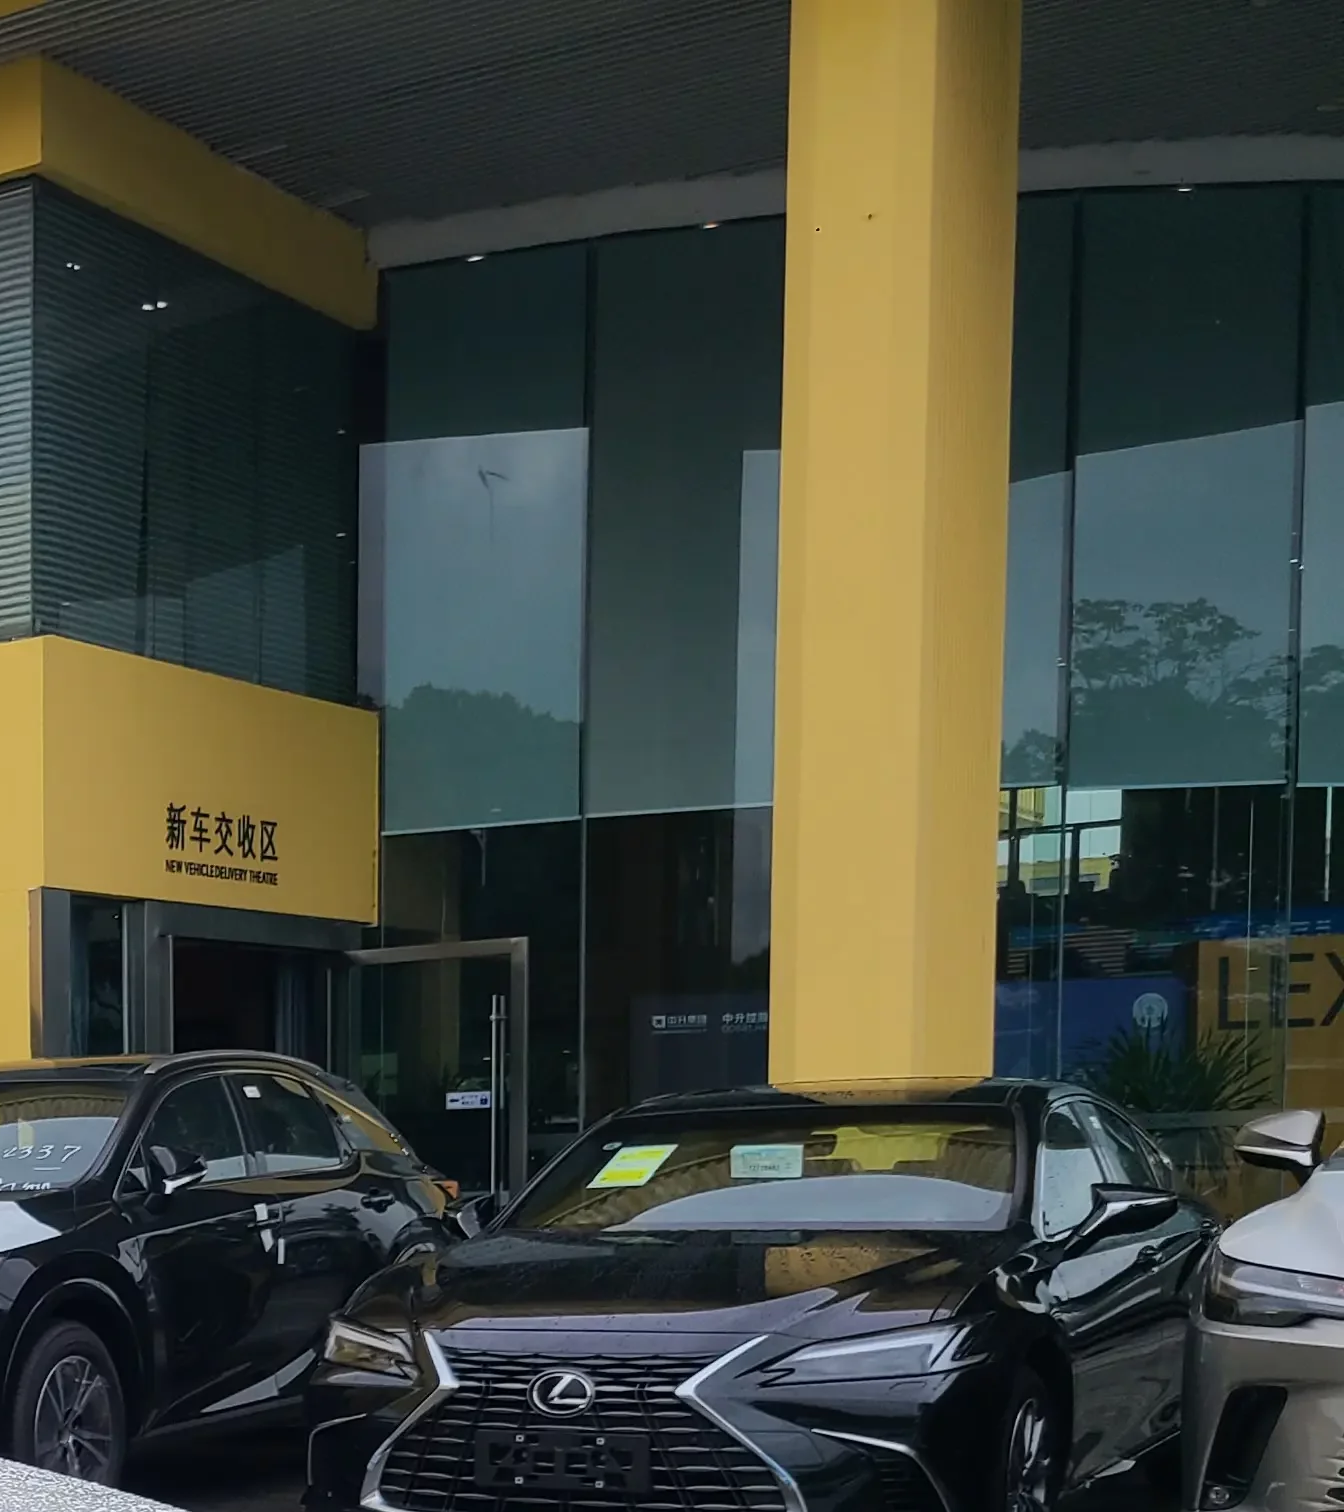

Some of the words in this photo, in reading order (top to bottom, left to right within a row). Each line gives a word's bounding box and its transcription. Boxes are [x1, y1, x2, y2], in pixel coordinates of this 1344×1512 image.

[165, 802, 278, 861] 新车交收区
[165, 860, 183, 873] NEW
[184, 861, 214, 878] VEHICLE
[214, 865, 248, 881] DELIVERY
[249, 869, 278, 886] THEATRE
